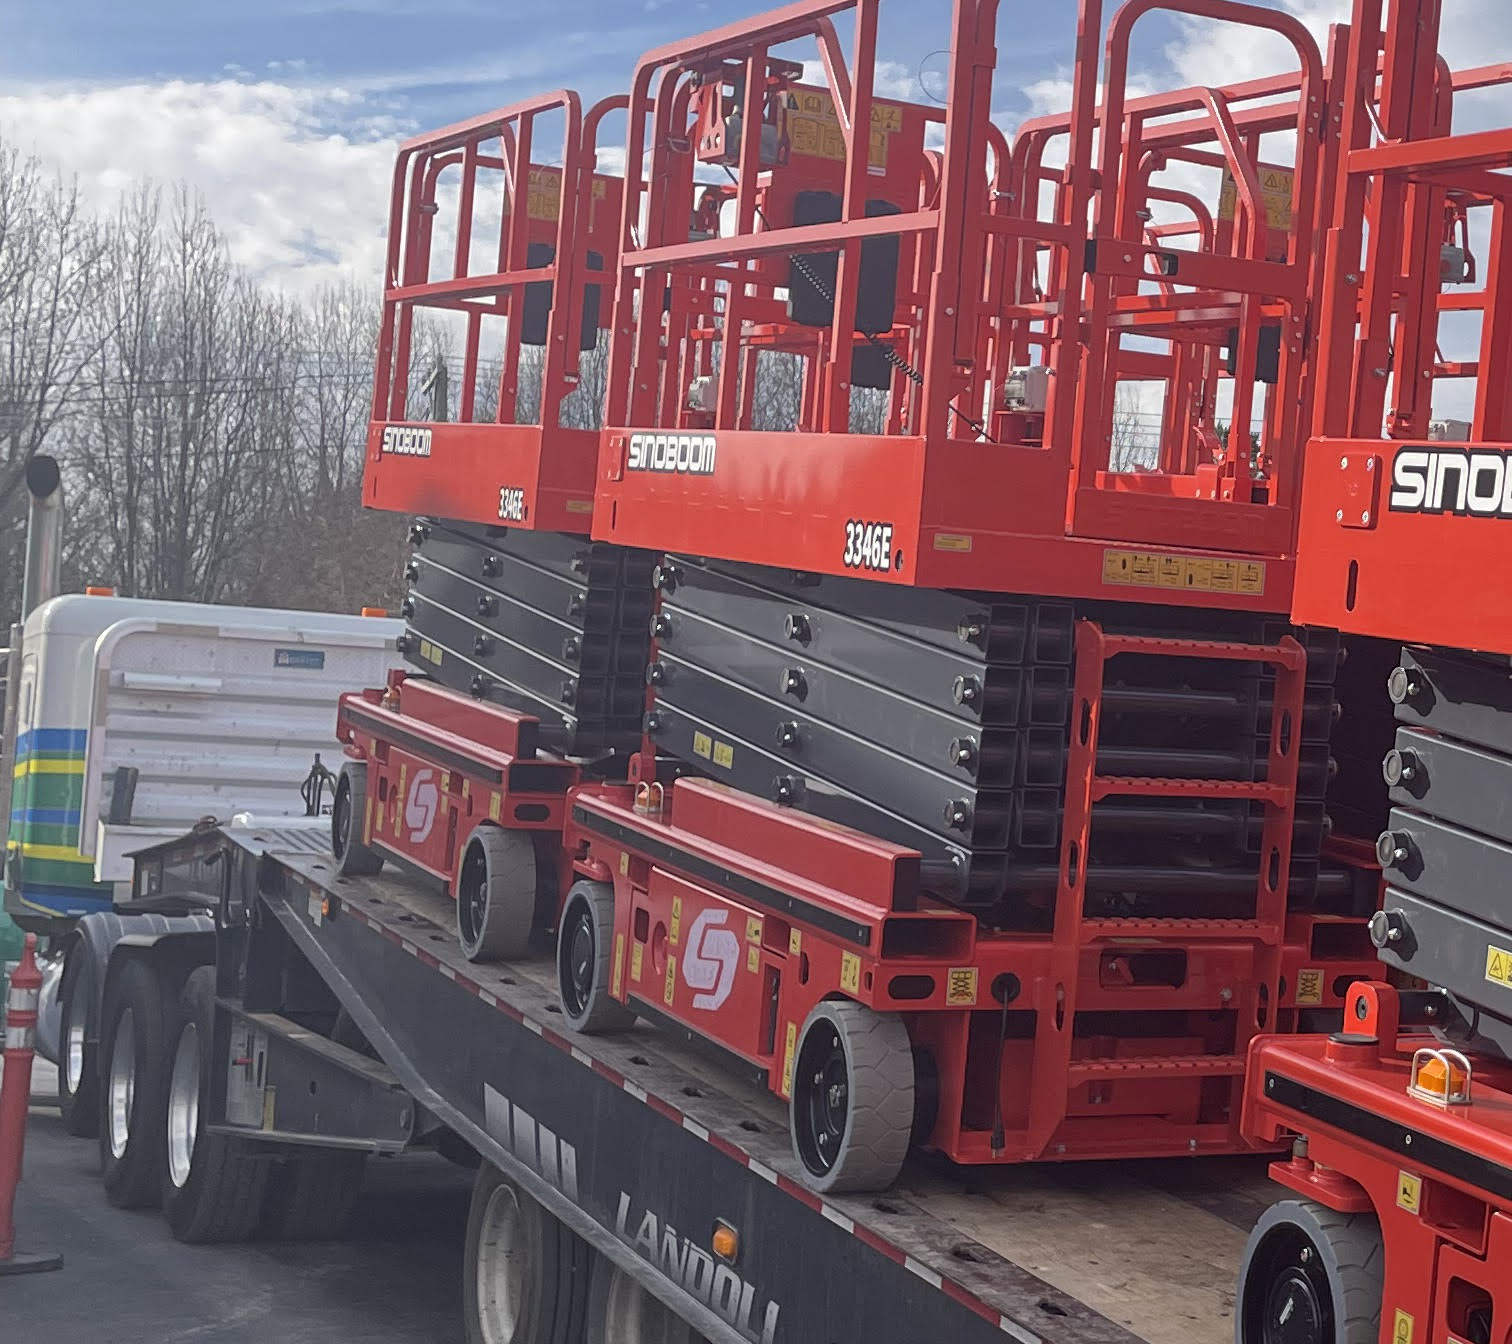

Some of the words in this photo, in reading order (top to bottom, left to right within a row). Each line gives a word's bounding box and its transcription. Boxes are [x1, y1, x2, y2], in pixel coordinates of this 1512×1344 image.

[383, 426, 432, 456] SINOBOOM
[628, 434, 717, 473] SINOBOOM
[498, 488, 524, 521] 3346E
[844, 522, 892, 569] 3346E
